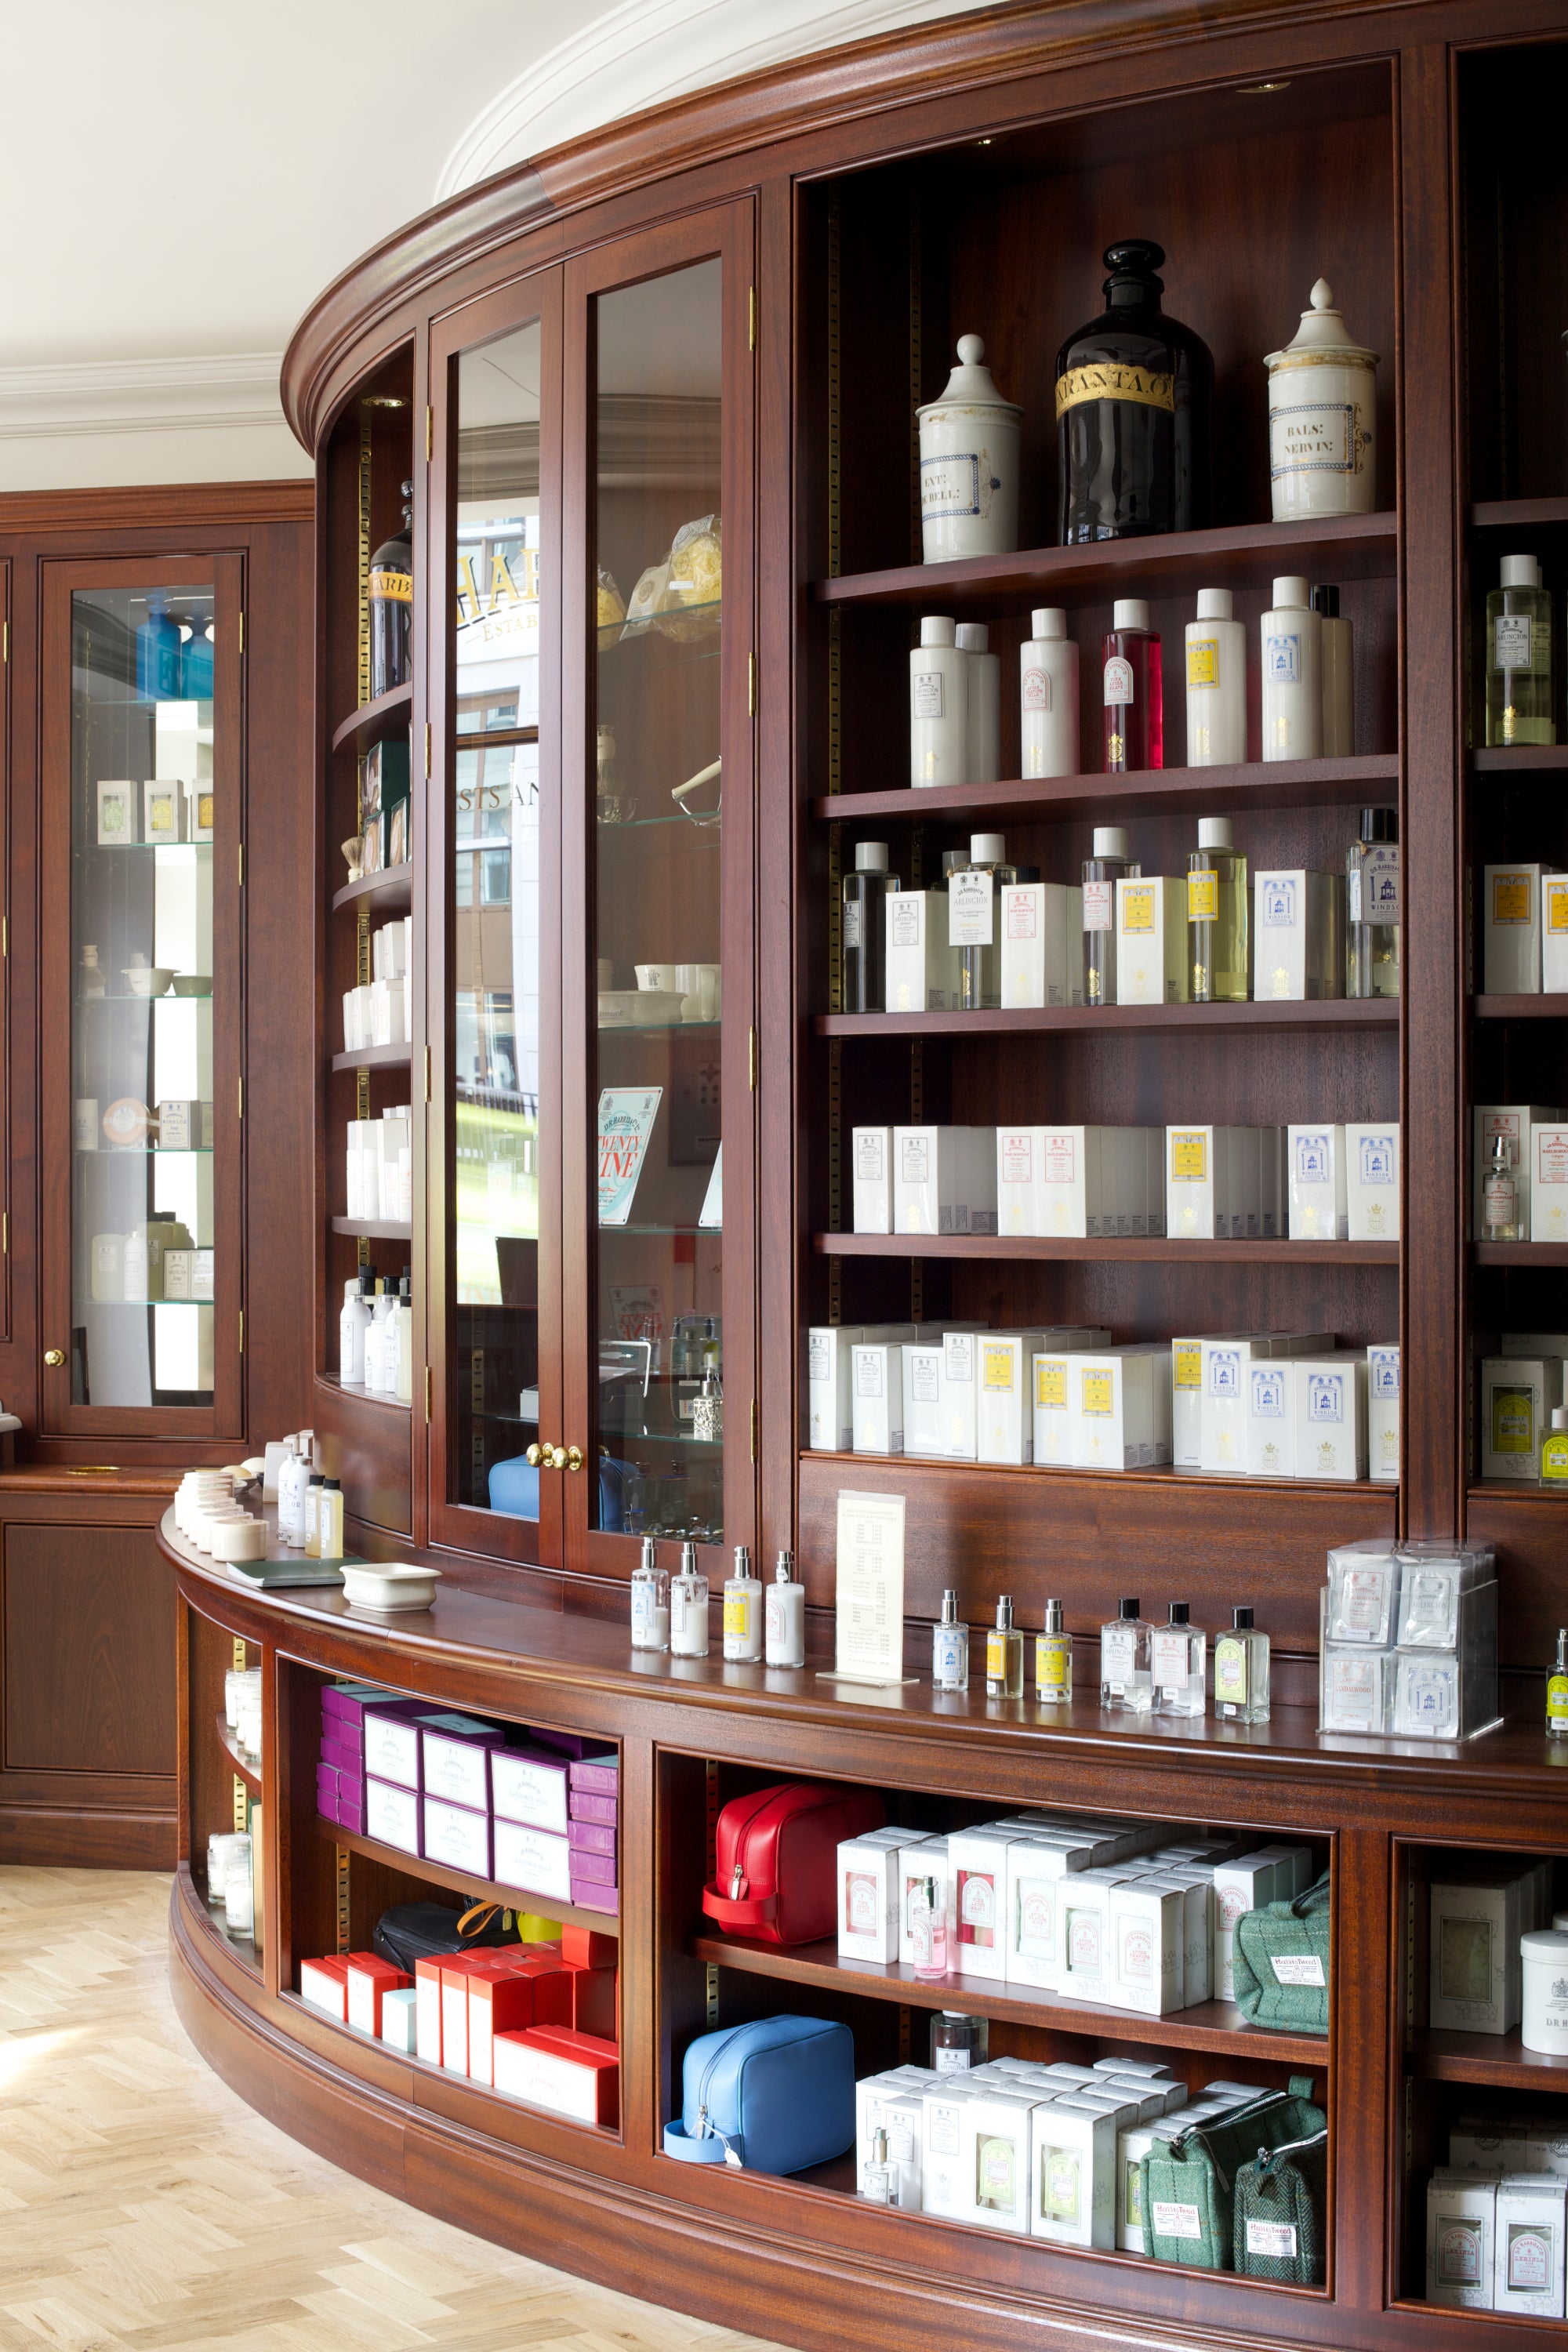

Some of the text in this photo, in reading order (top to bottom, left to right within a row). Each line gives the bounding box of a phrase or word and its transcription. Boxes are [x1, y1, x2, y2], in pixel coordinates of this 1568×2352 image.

[1287, 424, 1323, 437] BALS:
[954, 897, 988, 906] ARLINGTON
[597, 1135, 643, 1151] TWENTY
[598, 1152, 638, 1178] INE
[1412, 1600, 1447, 1609] ARLINGTON
[1156, 2205, 1196, 2215] Harris Tweed
[1250, 2223, 1292, 2234] Harris Tweed
